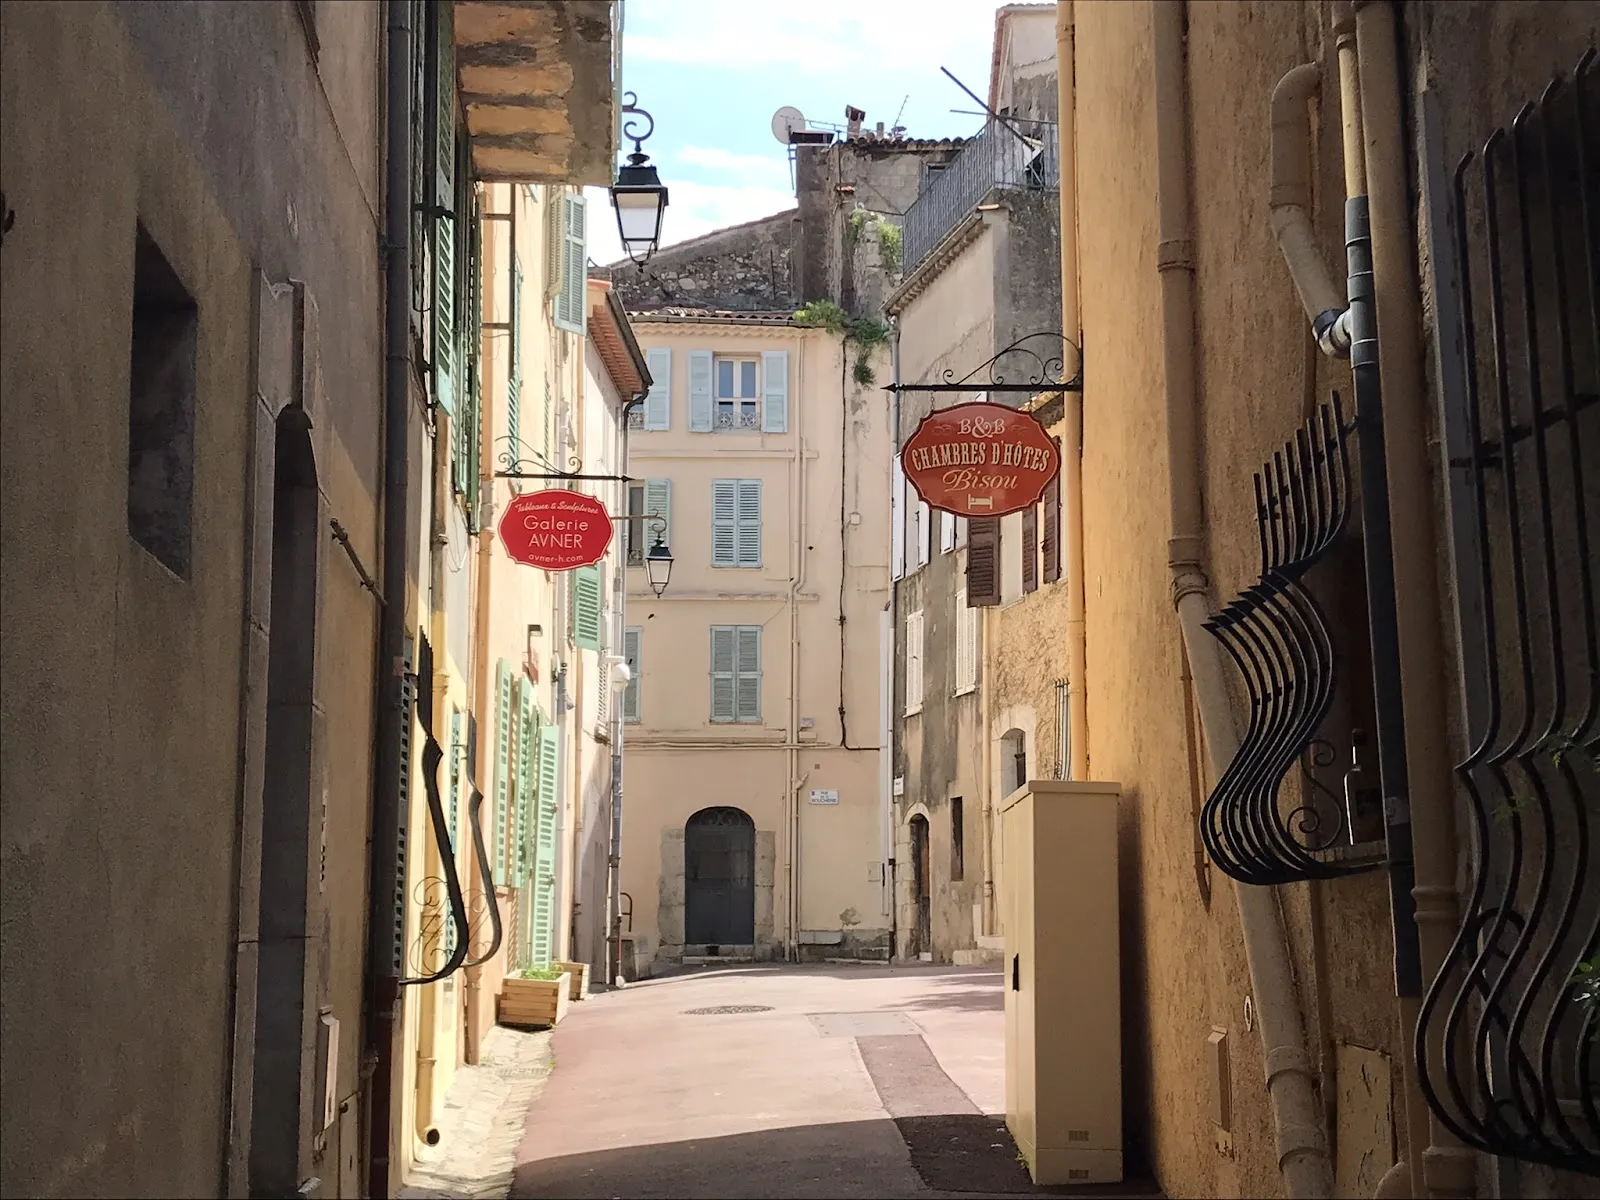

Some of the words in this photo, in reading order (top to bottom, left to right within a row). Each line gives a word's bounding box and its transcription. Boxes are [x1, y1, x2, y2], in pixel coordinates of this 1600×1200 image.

[957, 416, 1006, 438] B&B
[911, 442, 986, 472] CHAMBRES
[991, 440, 1050, 472] D'HÔTES
[942, 467, 1018, 492] Bisou
[515, 501, 549, 513] Tableaux
[557, 501, 599, 514] Sculptures
[523, 515, 589, 531] Galerie
[528, 534, 583, 548] AVNER
[528, 553, 584, 563] avner-h.com
